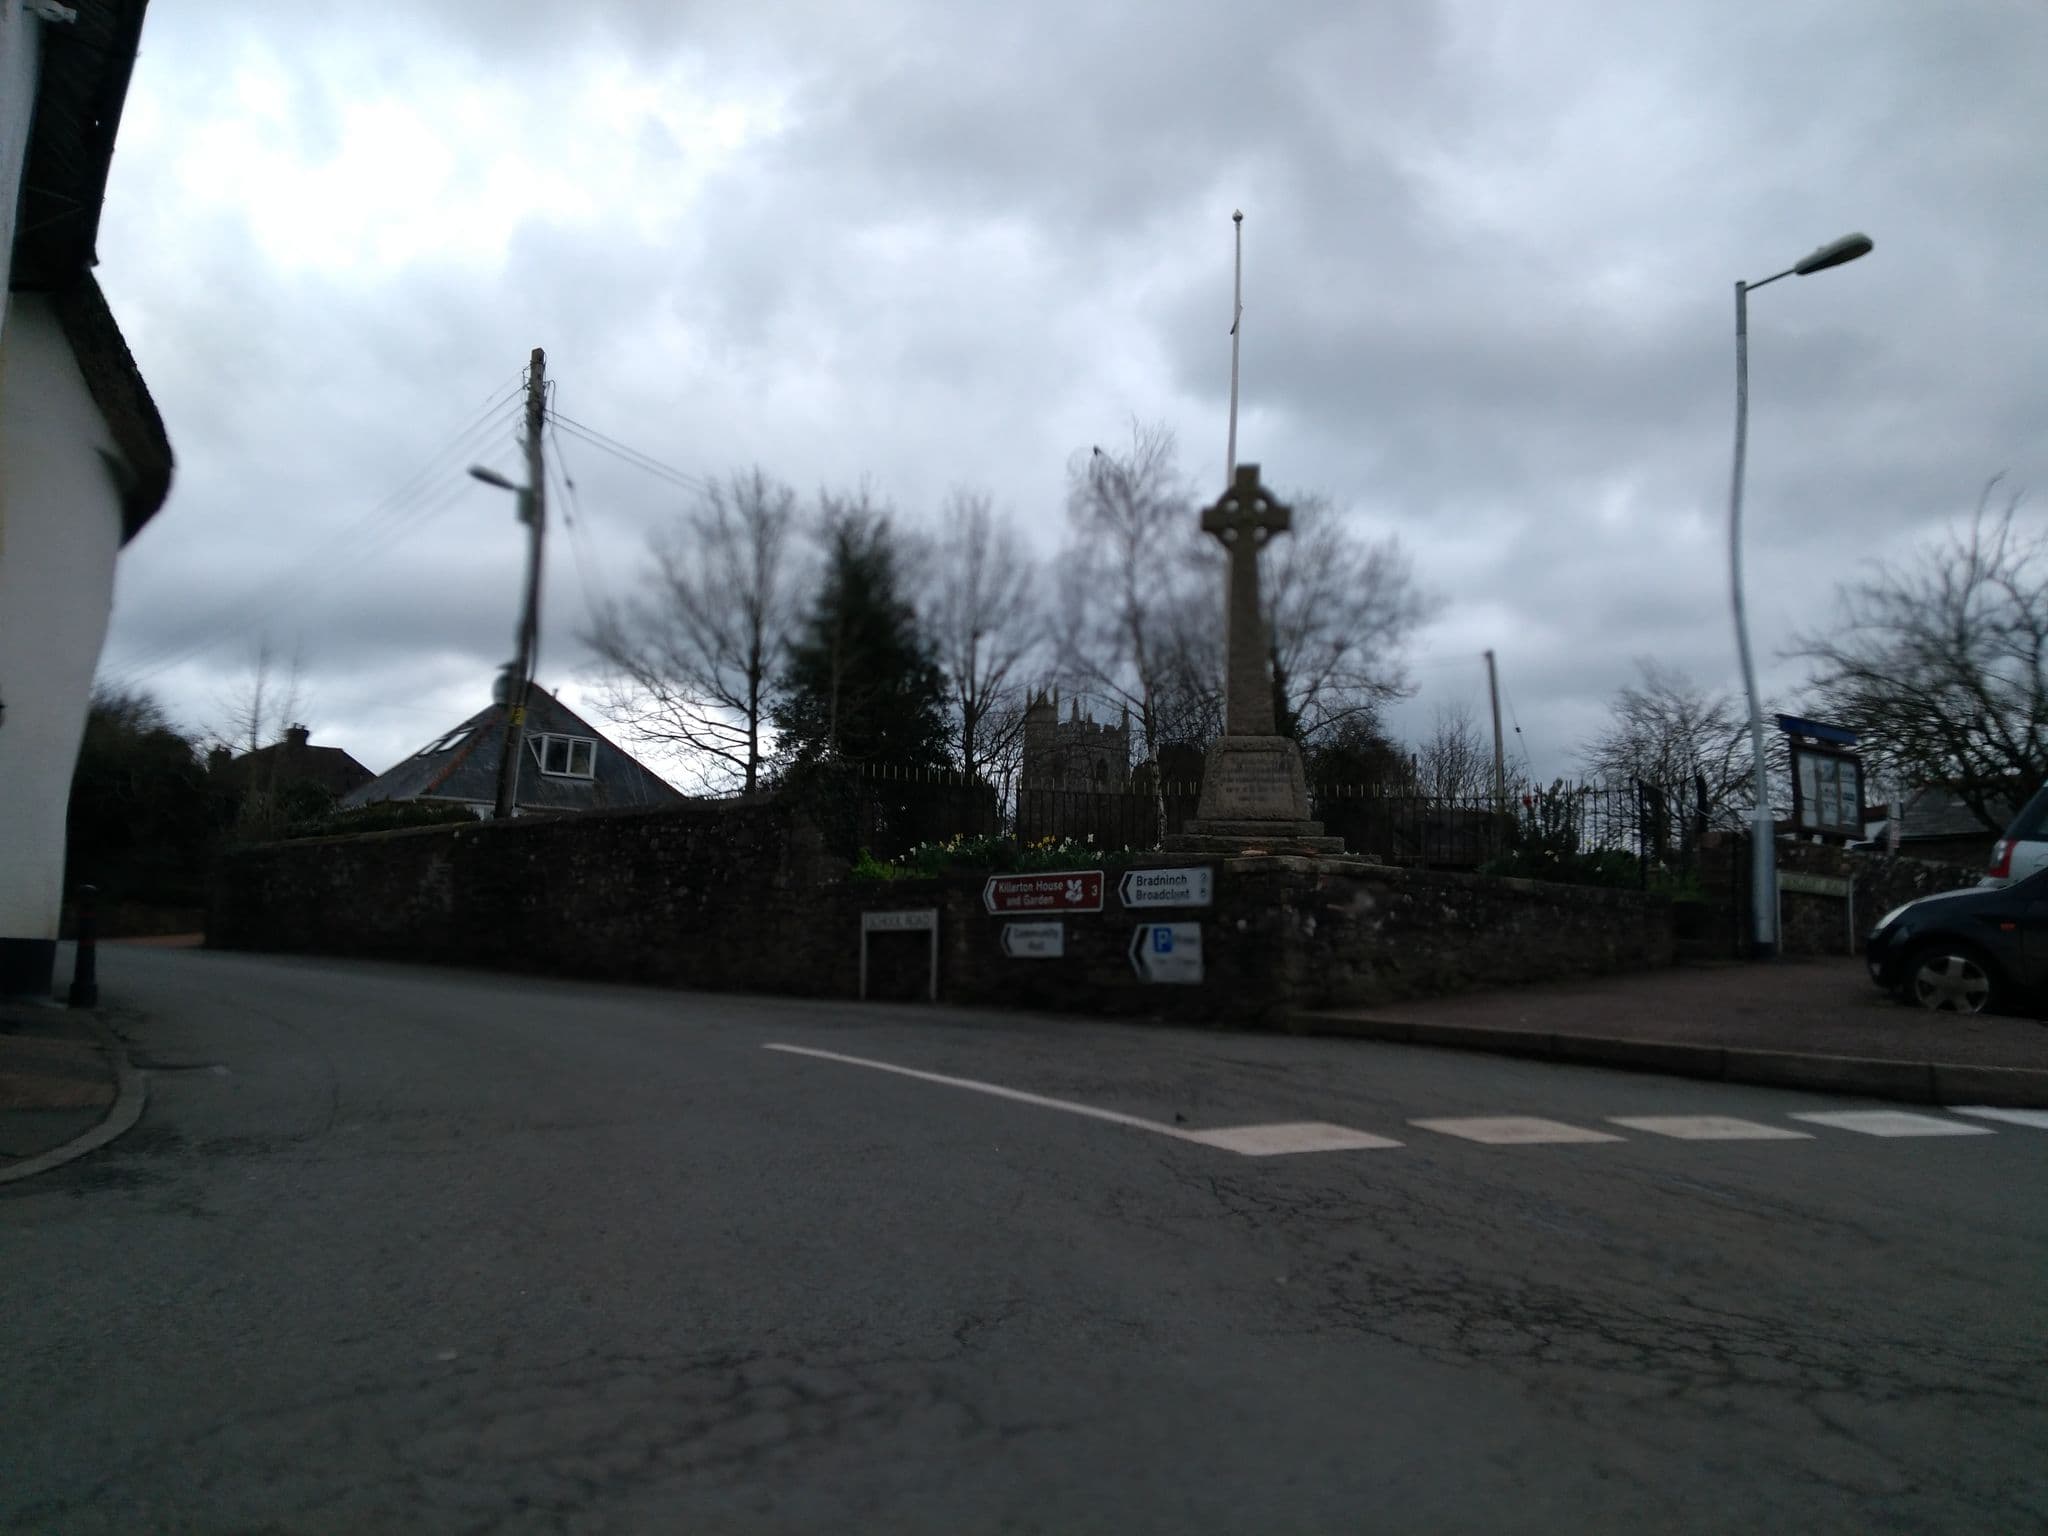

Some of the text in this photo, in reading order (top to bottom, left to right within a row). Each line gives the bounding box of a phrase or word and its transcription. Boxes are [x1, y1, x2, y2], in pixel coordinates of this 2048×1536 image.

[998, 880, 1064, 893] Killerton House
[1136, 875, 1188, 887] Bradninch
[1090, 884, 1098, 897] 3
[1023, 894, 1055, 906] Garden
[1157, 930, 1168, 950] P
